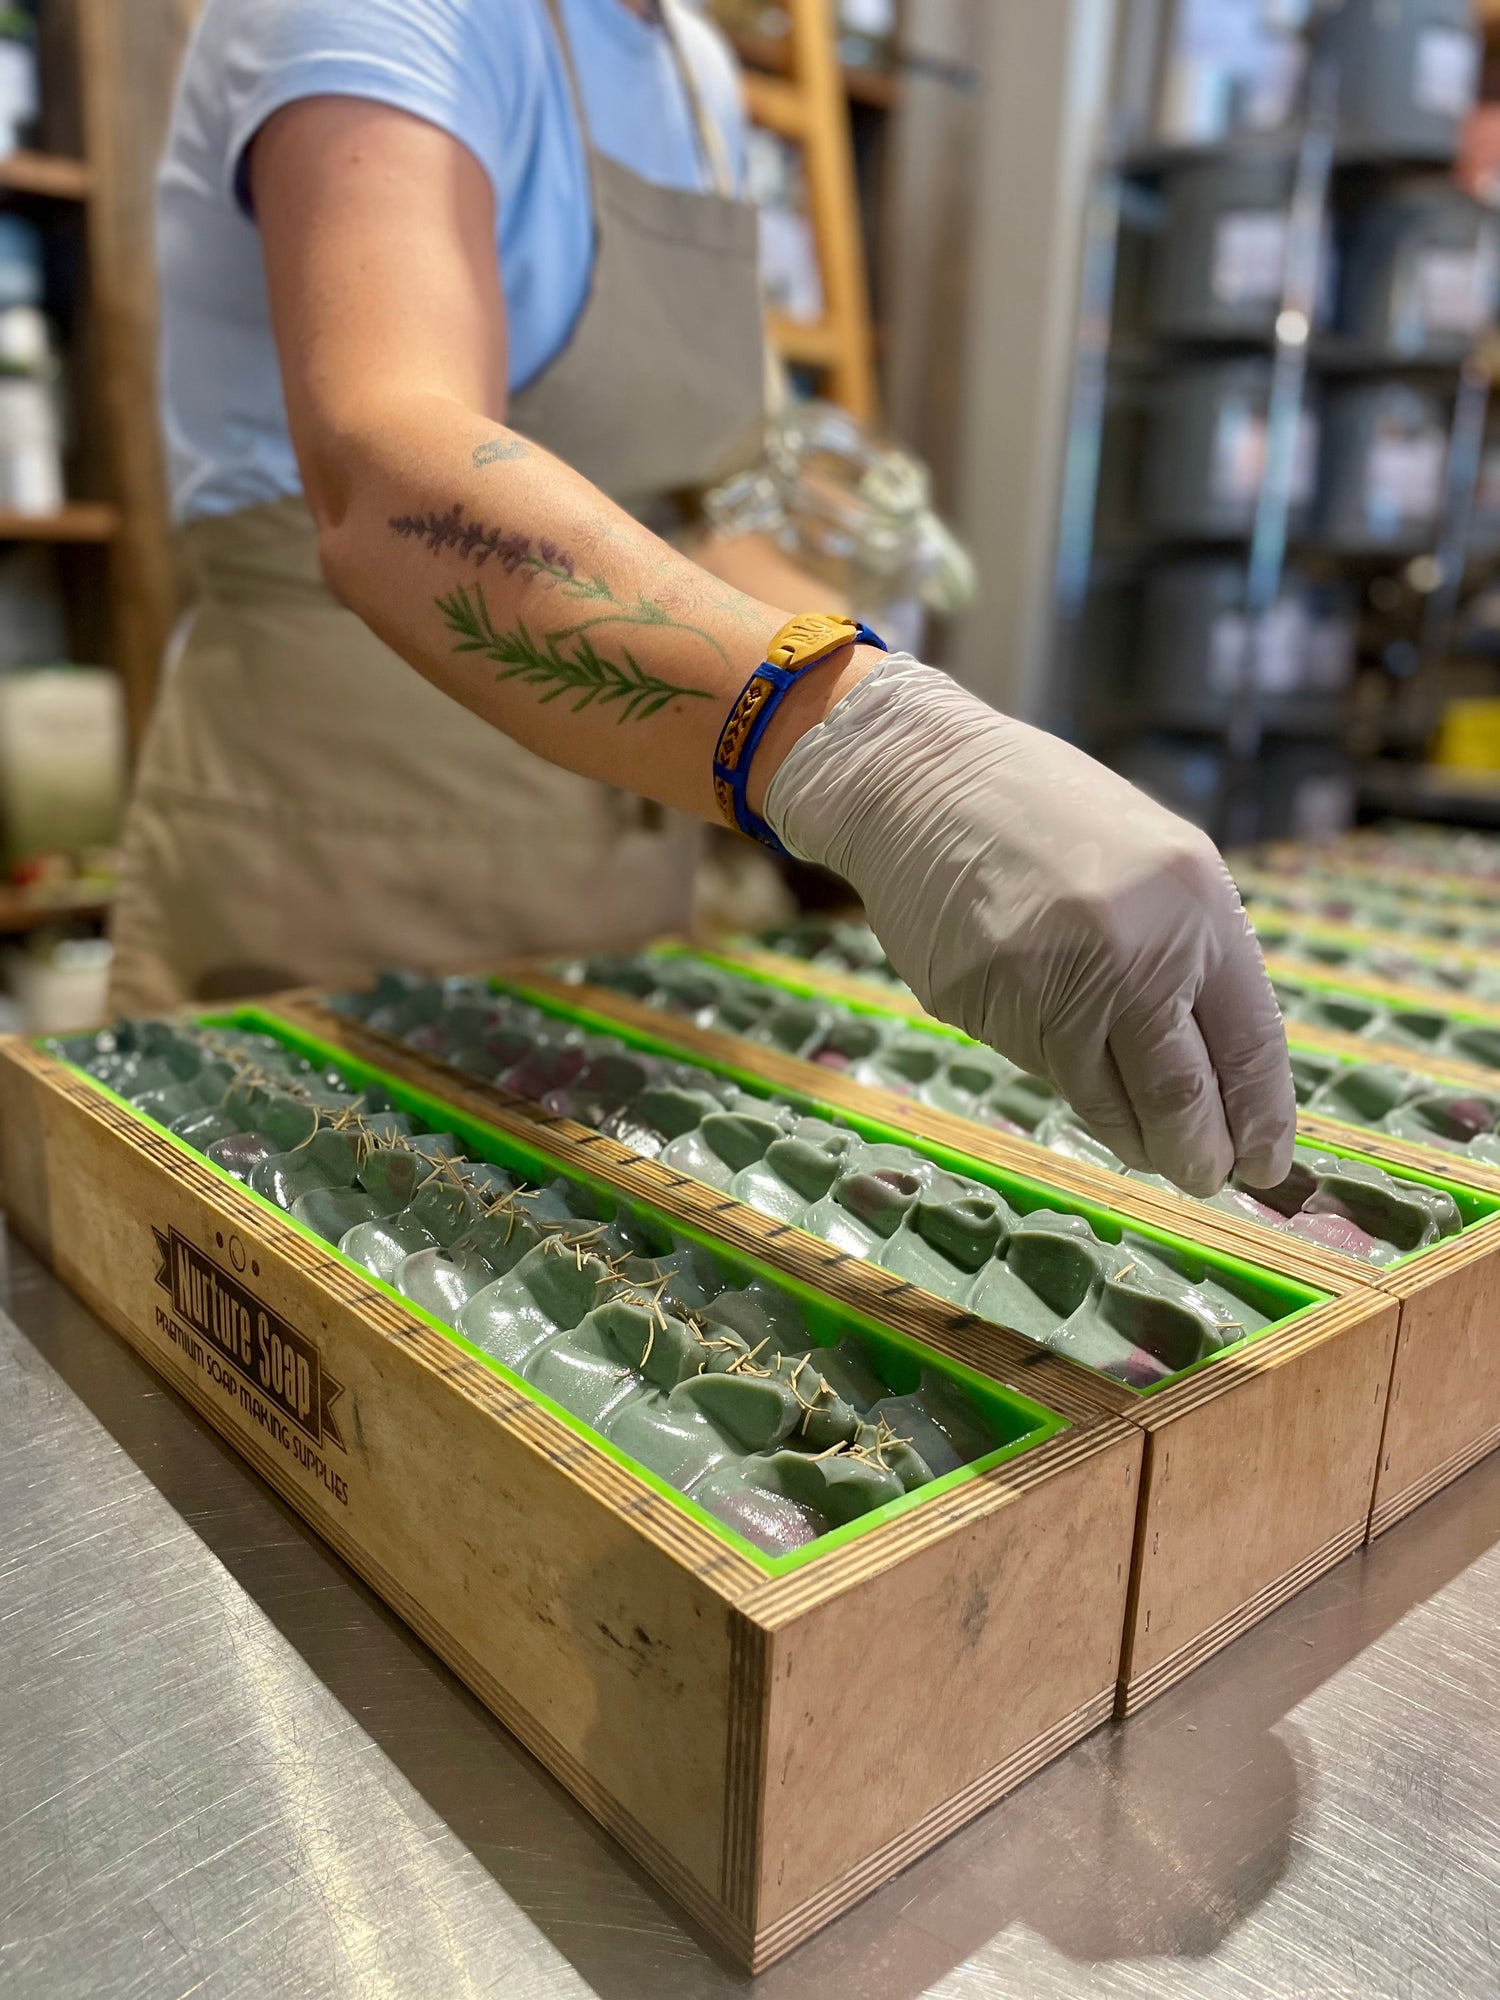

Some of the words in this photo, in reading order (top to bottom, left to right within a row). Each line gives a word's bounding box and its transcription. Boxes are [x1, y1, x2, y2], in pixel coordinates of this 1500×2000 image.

[156, 1307, 204, 1369] PREMIUM
[207, 1354, 237, 1396] SOAP
[240, 1388, 290, 1450] MAKING
[294, 1436, 348, 1506] SUPPLIES
[177, 1241, 251, 1367] Nurture
[258, 1311, 310, 1420] Soap
